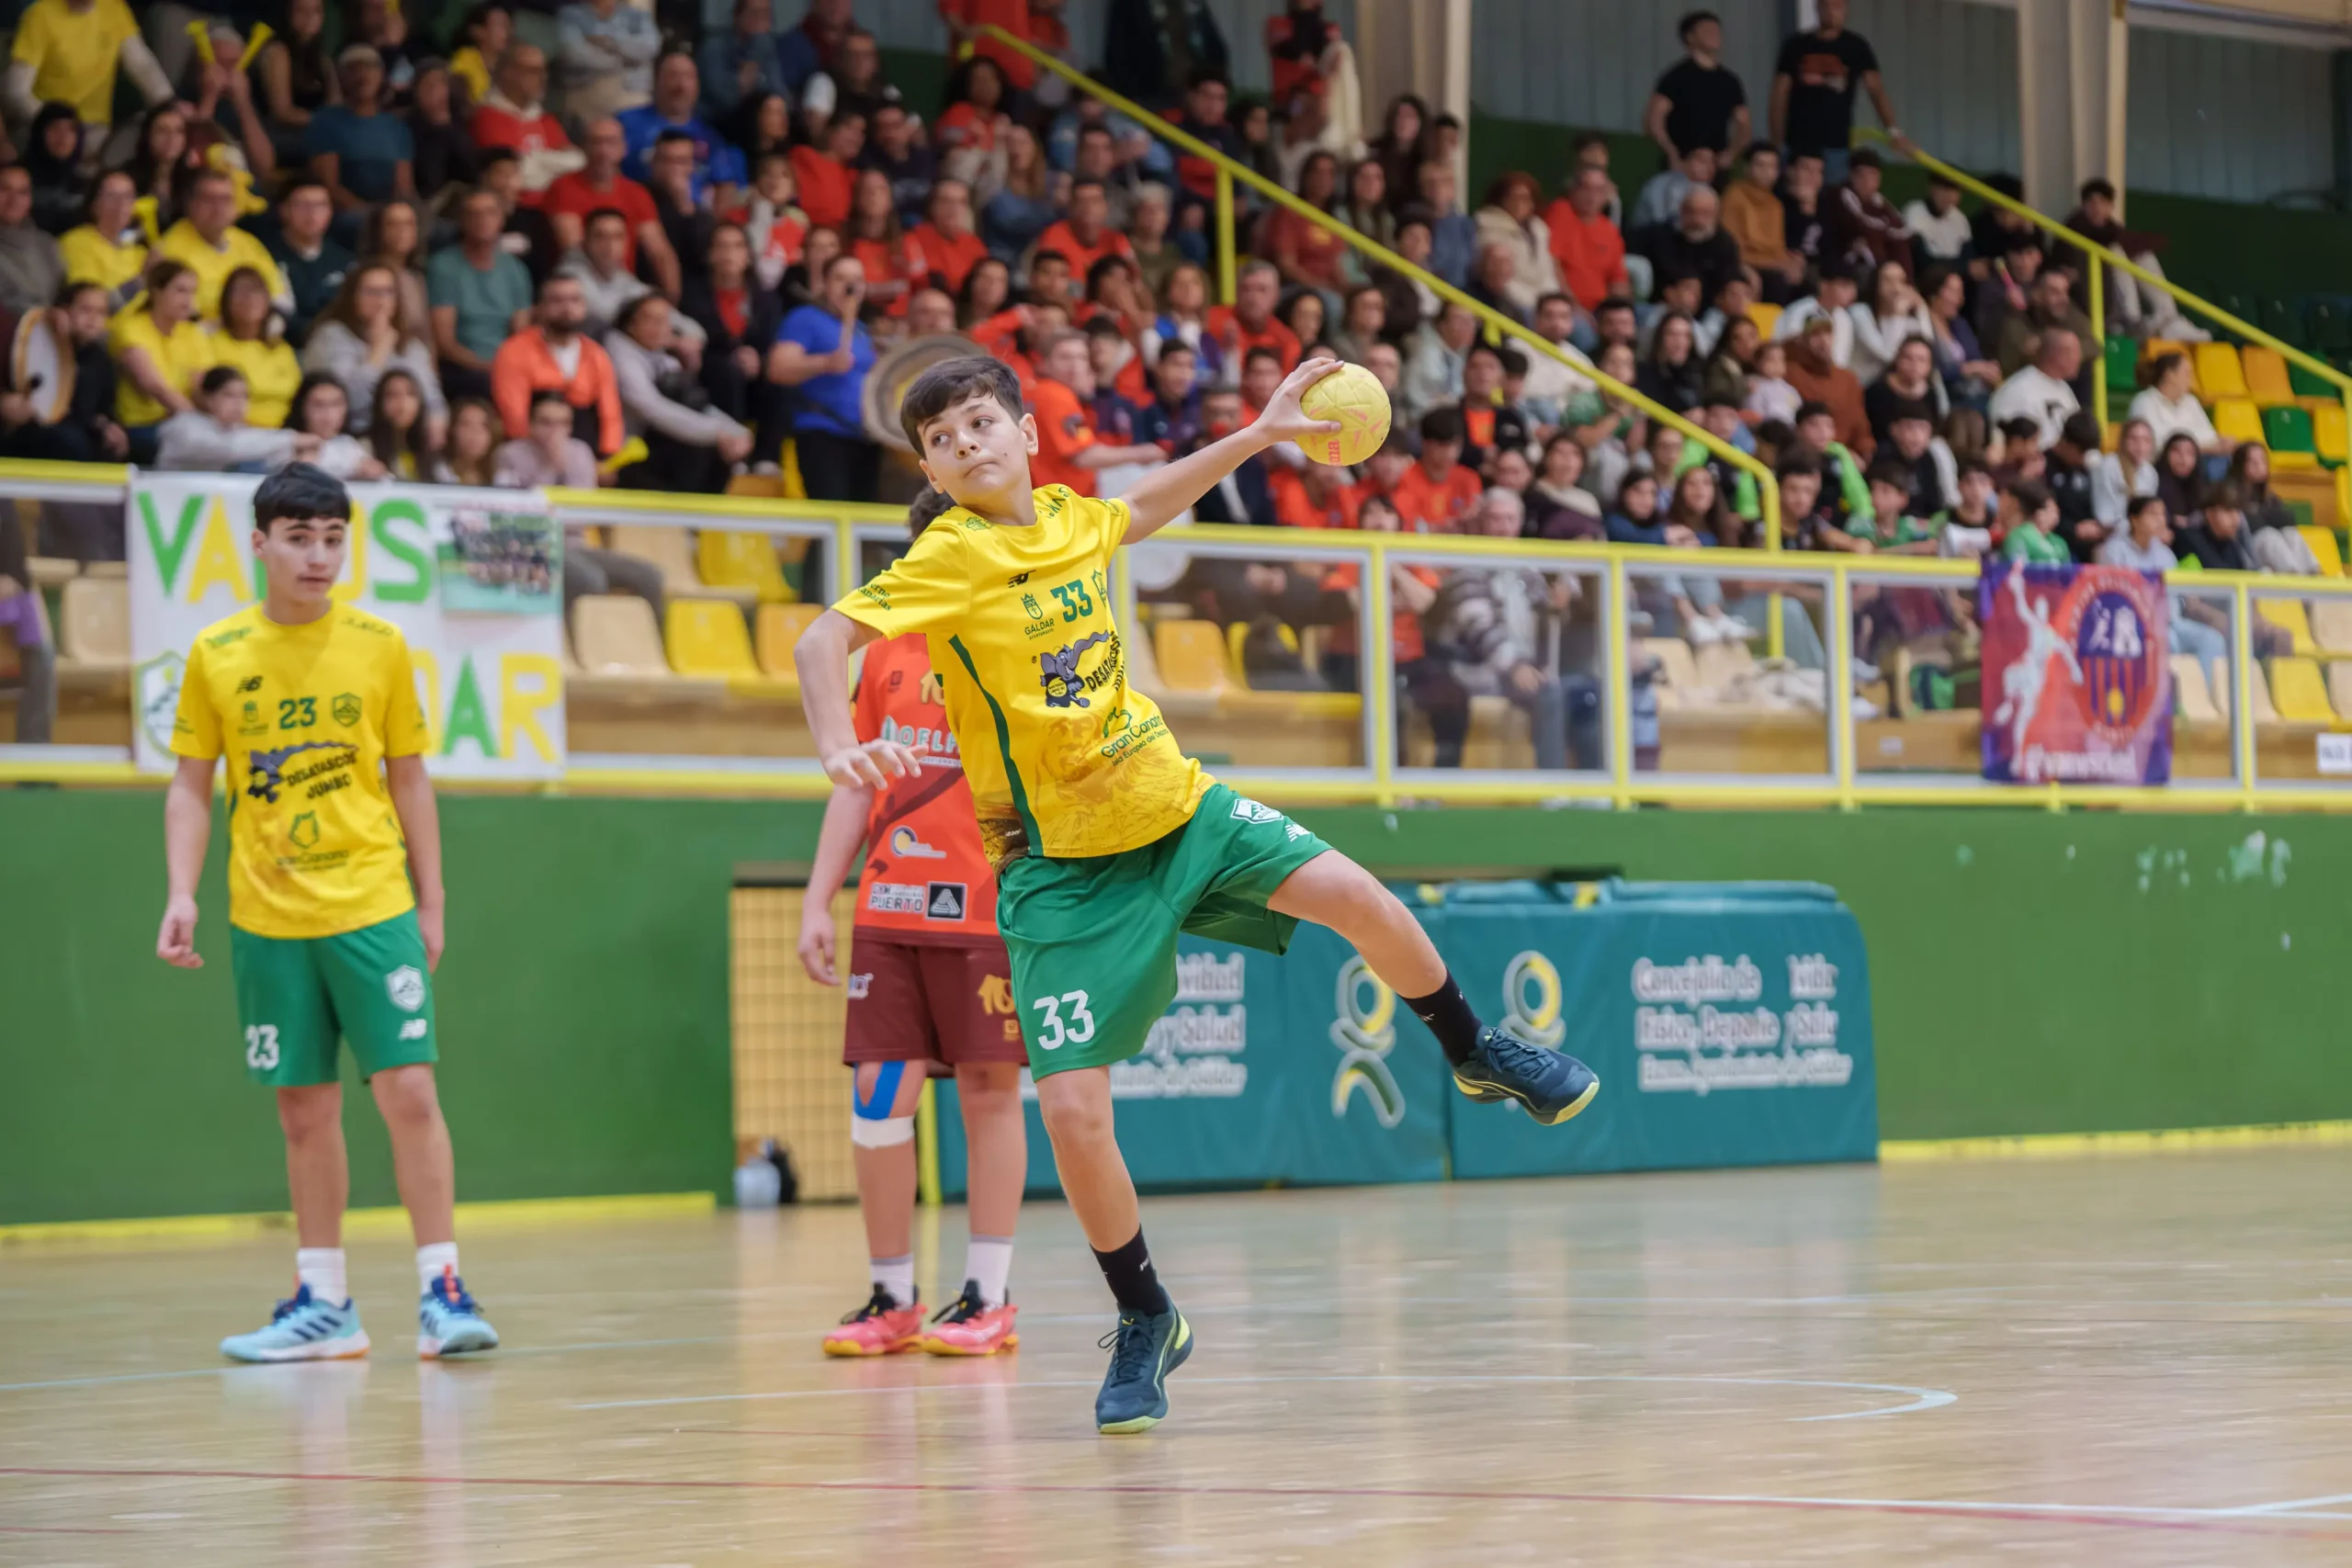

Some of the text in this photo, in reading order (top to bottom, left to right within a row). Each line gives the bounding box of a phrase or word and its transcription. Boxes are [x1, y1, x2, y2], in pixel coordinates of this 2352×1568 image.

[137, 491, 430, 604] VAOS
[1050, 579, 1093, 623] 33
[279, 697, 317, 729] 23
[871, 896, 923, 912] PUERTO
[1034, 989, 1095, 1050] 33
[245, 1023, 279, 1070] 23
